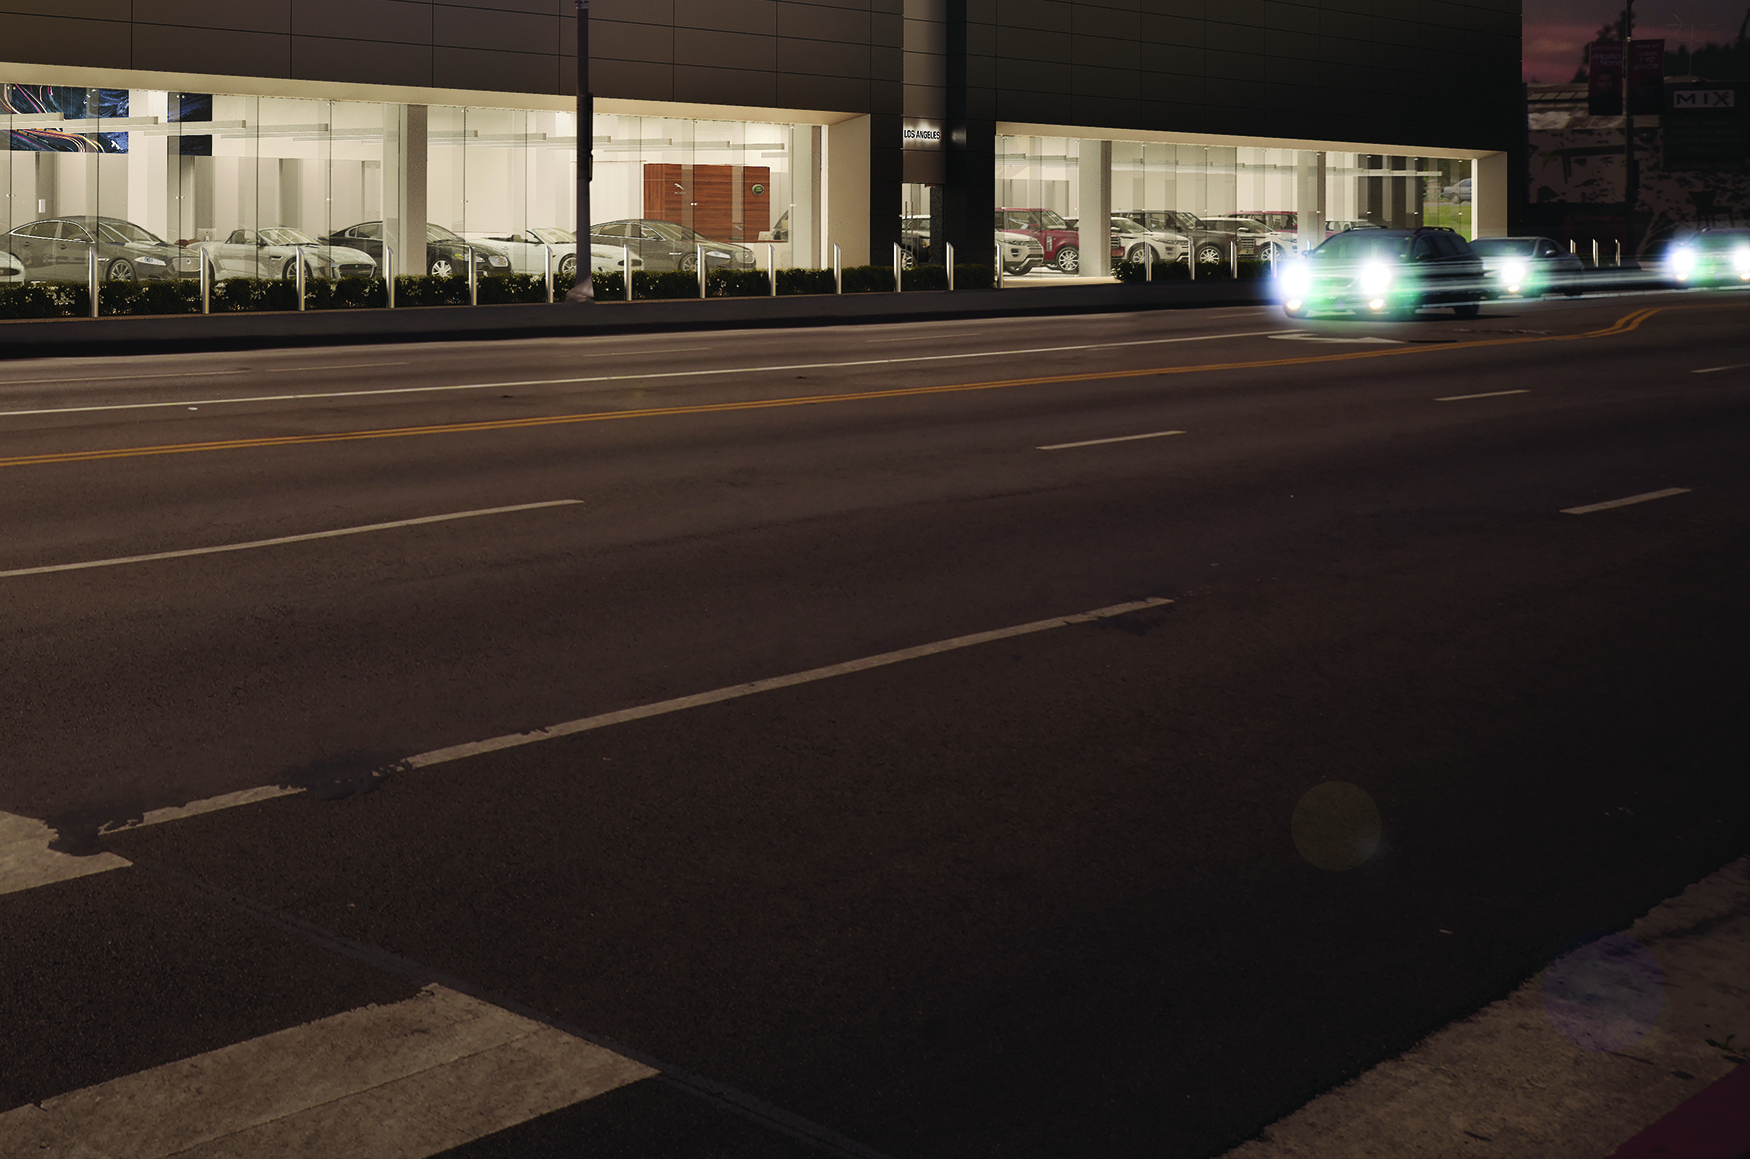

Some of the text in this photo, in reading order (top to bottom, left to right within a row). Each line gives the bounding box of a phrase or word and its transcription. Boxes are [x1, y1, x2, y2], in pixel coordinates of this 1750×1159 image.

[1676, 91, 1730, 106] MIX
[904, 130, 941, 140] LOS ANGELES
